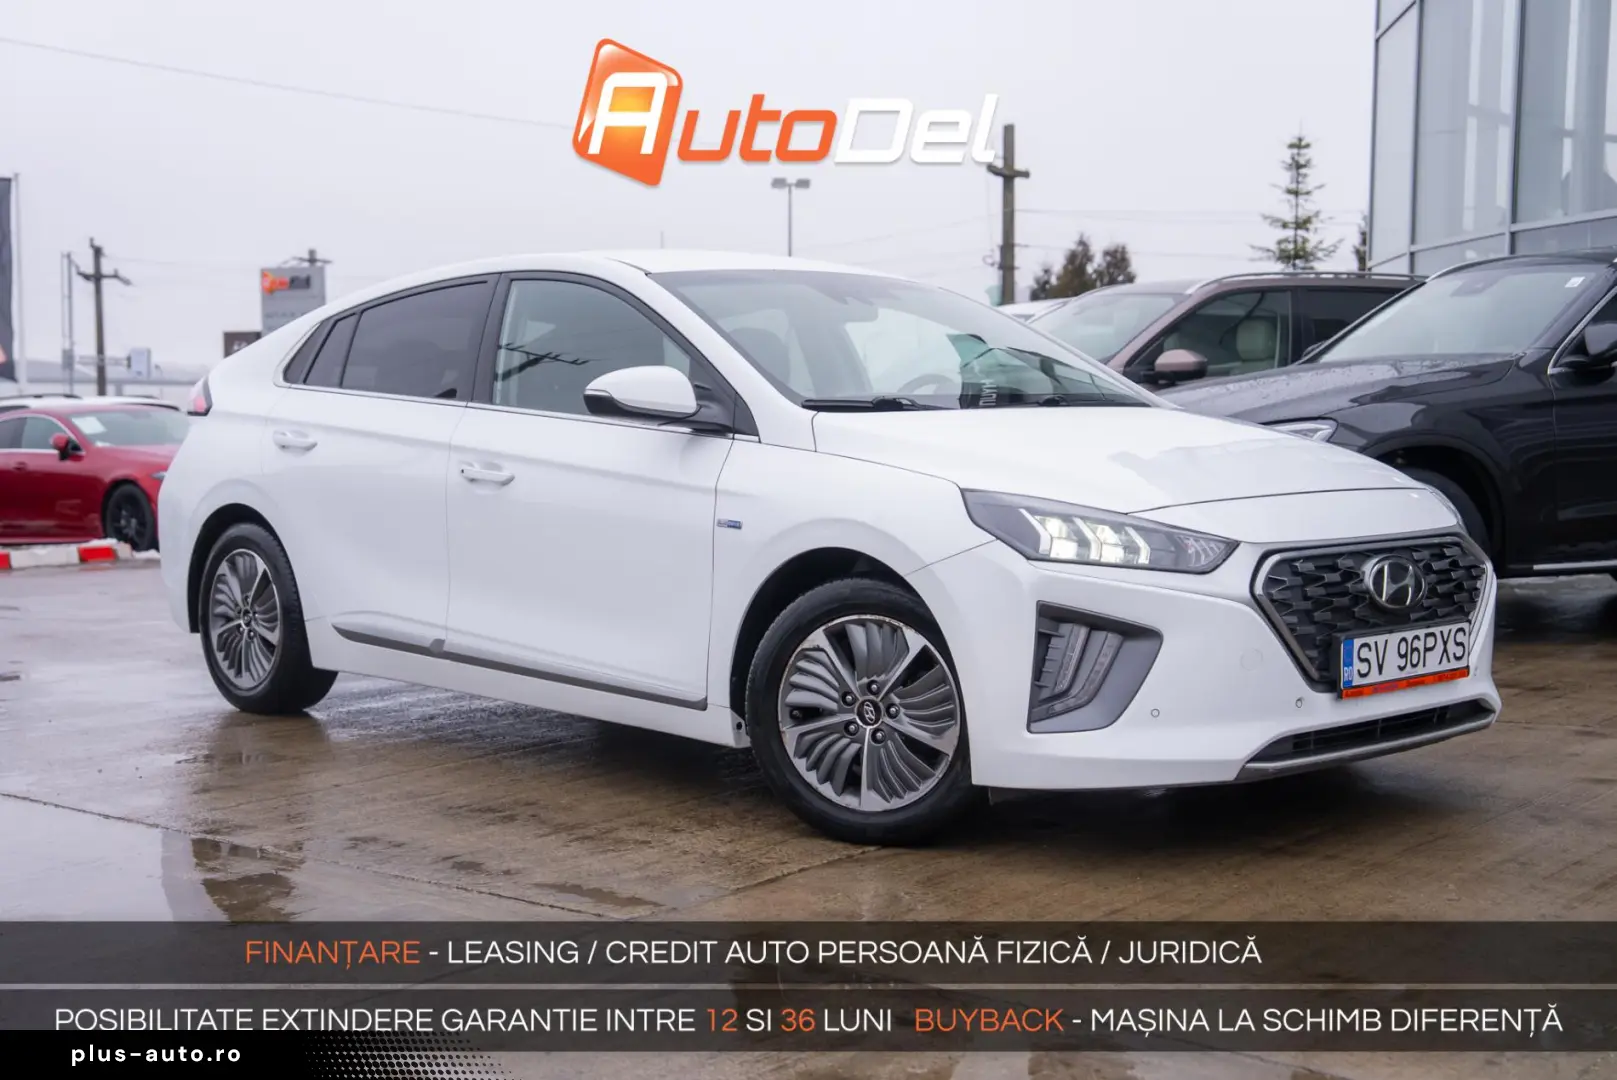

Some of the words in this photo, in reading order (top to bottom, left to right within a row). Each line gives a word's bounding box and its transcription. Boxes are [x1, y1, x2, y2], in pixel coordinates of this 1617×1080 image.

[1356, 638, 1389, 679] SV
[1396, 626, 1467, 672] 96PXS
[1343, 666, 1354, 682] RO
